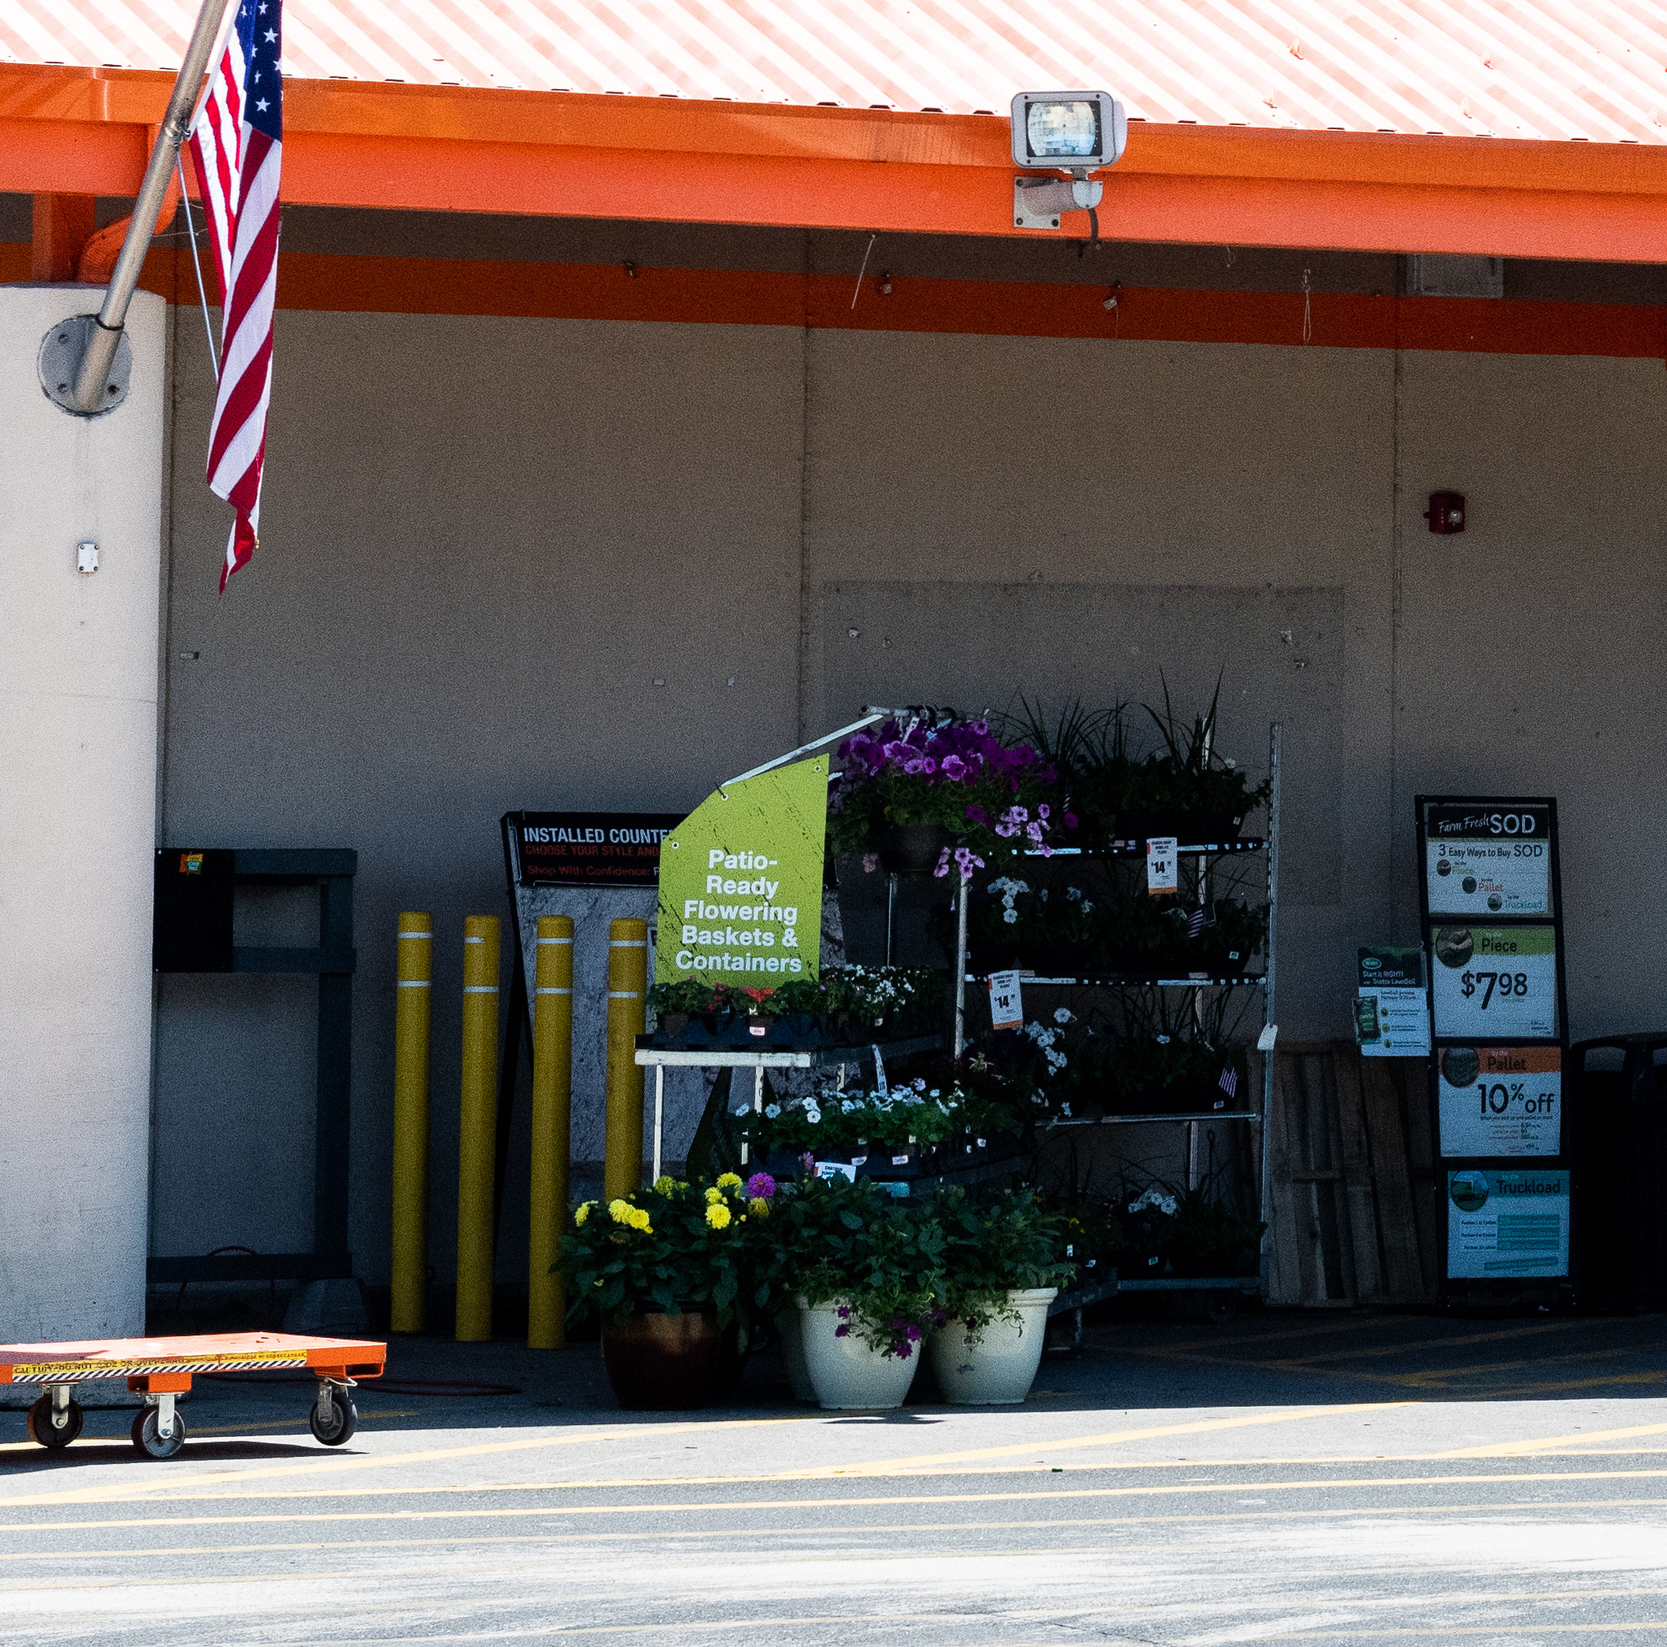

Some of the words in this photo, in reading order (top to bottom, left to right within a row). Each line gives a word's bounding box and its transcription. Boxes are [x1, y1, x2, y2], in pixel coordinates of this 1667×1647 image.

[1438, 820, 1462, 834] Farm
[1463, 813, 1490, 829] Fresh
[1490, 814, 1536, 834] SOD
[523, 827, 605, 843] INSTALLED
[609, 829, 672, 844] COUNTE
[525, 845, 567, 856] CHOOSE
[570, 846, 599, 855] YOUR
[602, 846, 633, 856] STYLE
[637, 847, 659, 857] AND
[709, 849, 778, 870] Patio-
[1439, 844, 1446, 856] 3
[1449, 847, 1465, 858] Easy
[1467, 847, 1486, 858] Ways
[1498, 848, 1511, 858] Buy
[1514, 845, 1542, 857] SOD
[527, 866, 556, 876] Shop
[559, 867, 584, 875] With
[586, 866, 650, 876] Confidence:
[706, 875, 779, 899] Ready
[1479, 883, 1503, 892] Pallet
[684, 900, 797, 926] Flowering
[682, 925, 775, 946] Baskets
[782, 928, 798, 947] &
[1482, 939, 1517, 952] Piece
[676, 950, 802, 972] Containers
[1488, 1057, 1526, 1070] Pallet
[1478, 1083, 1524, 1113] 10%
[1525, 1094, 1554, 1113] off
[1497, 1180, 1560, 1193] Truckload
